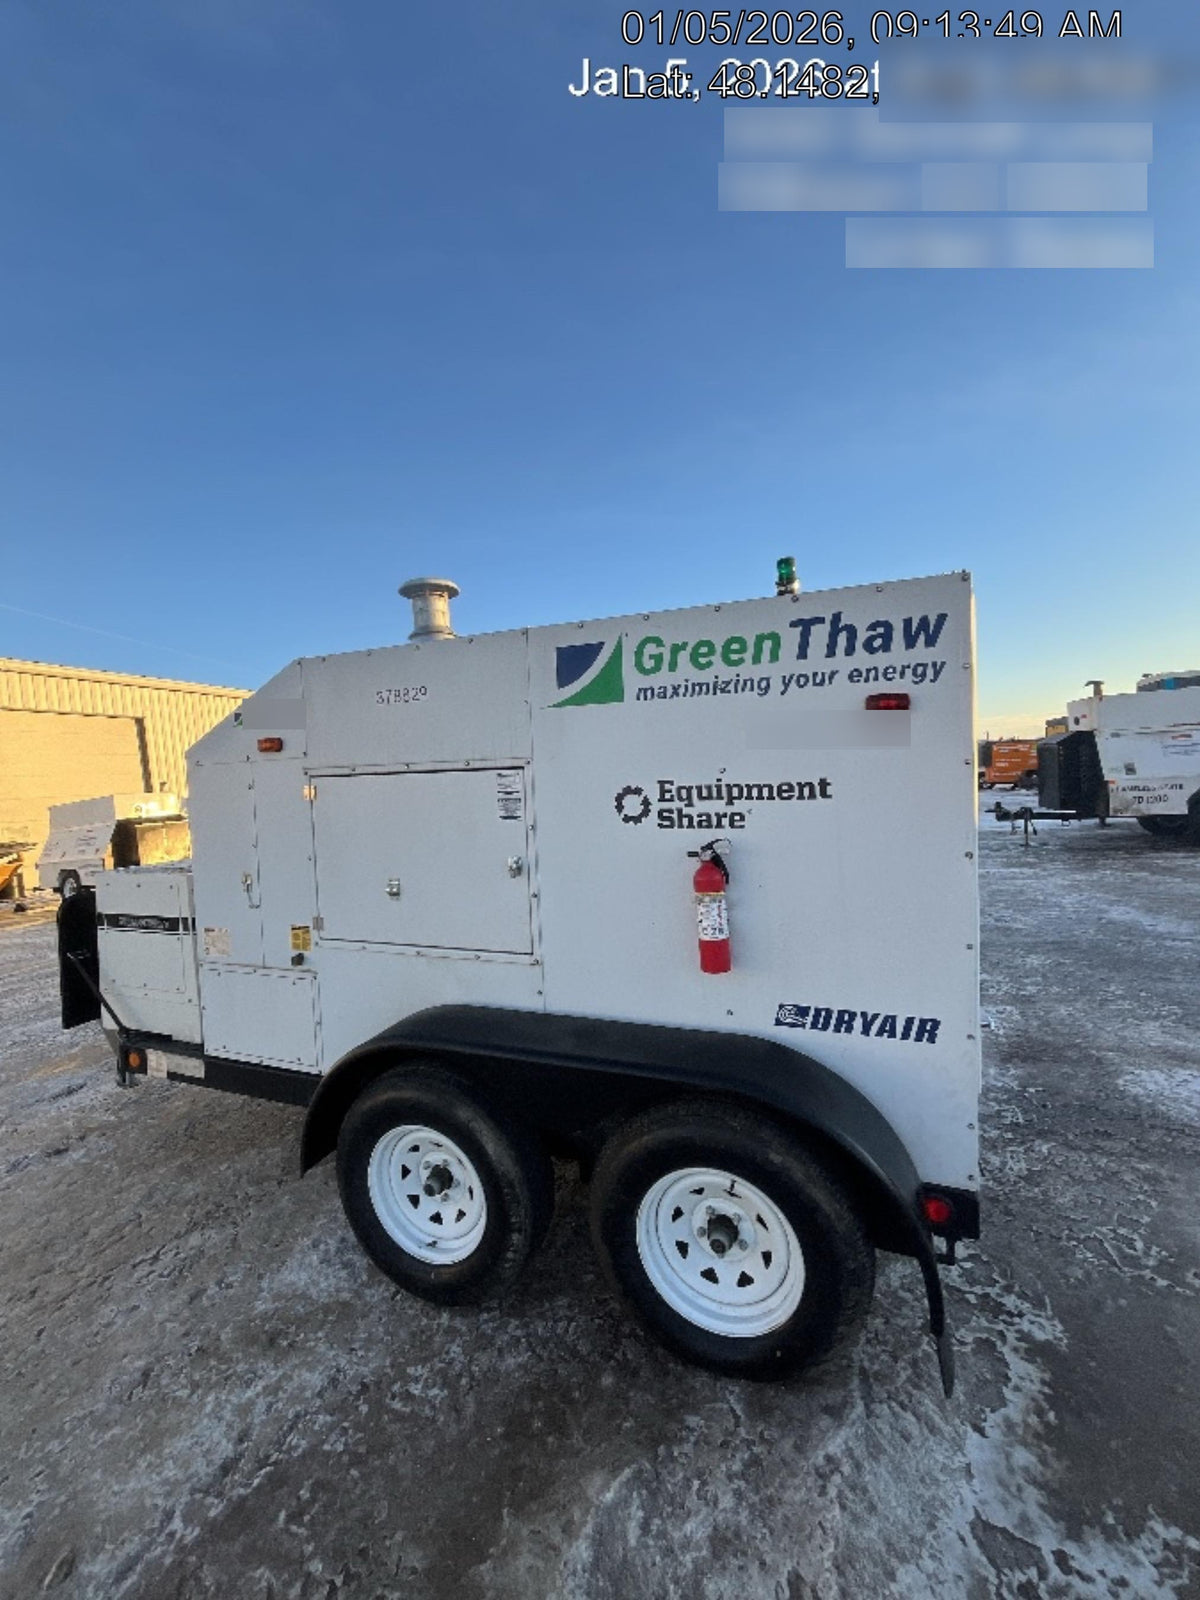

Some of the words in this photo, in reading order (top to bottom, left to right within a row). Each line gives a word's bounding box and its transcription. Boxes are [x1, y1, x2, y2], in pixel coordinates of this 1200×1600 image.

[636, 674, 771, 701] maximizing
[780, 667, 839, 698] your
[848, 660, 946, 686] energy
[656, 776, 833, 806] Equipment
[656, 808, 746, 830] Share
[809, 1005, 941, 1044] DRYAIR
